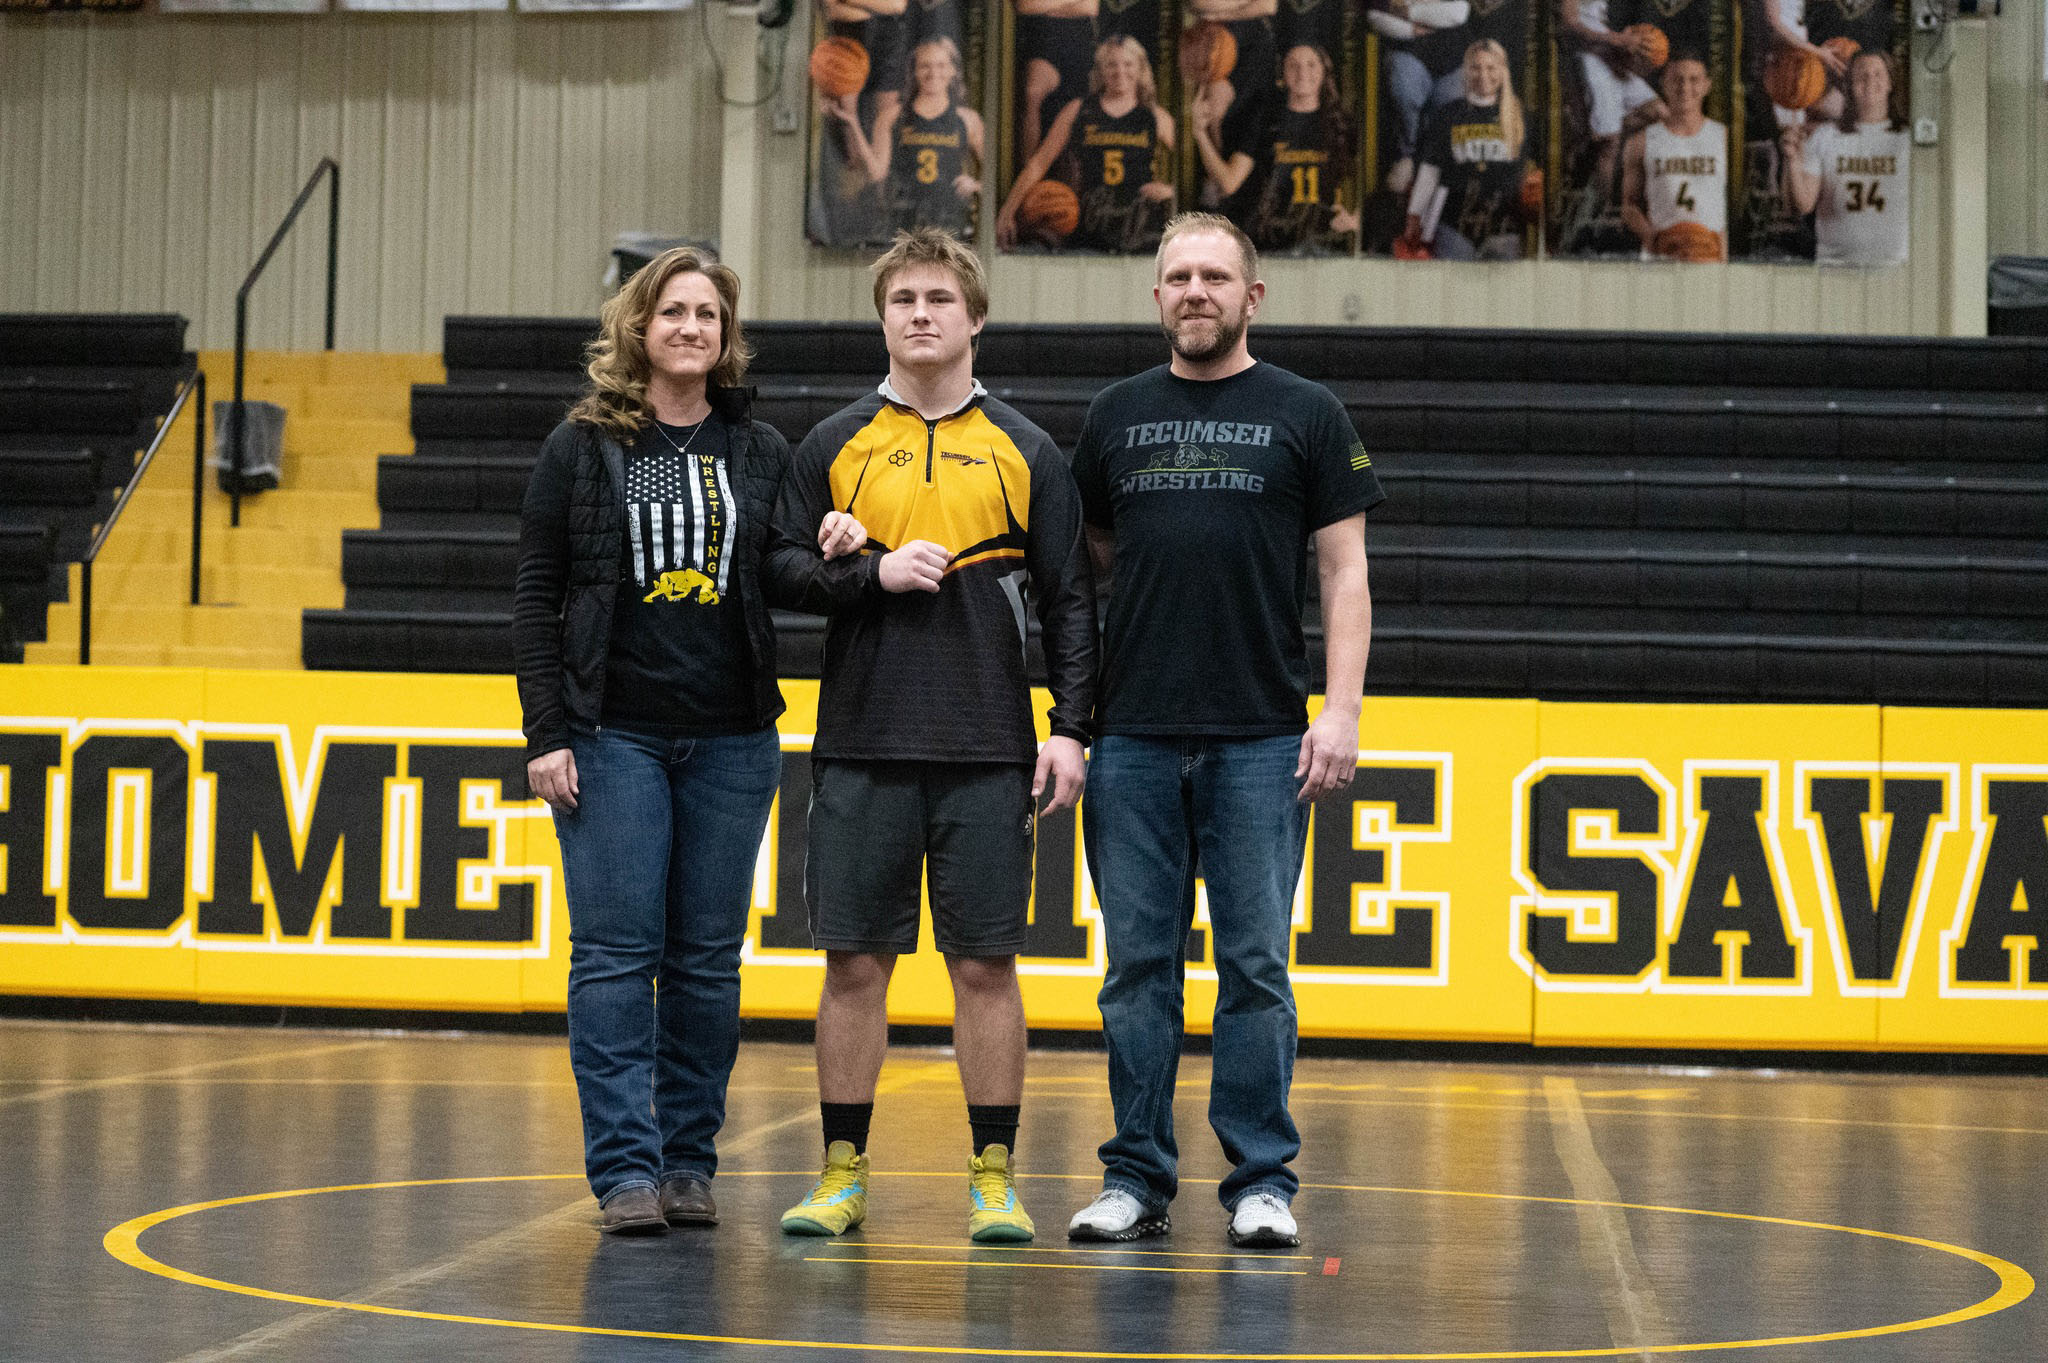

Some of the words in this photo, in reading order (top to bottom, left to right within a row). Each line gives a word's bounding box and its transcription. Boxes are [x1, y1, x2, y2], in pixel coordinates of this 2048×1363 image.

[916, 148, 939, 184] 3
[1103, 149, 1125, 186] 5
[1291, 165, 1319, 204] 11
[1676, 181, 1696, 212] 4
[1846, 181, 1886, 212] 34
[1125, 420, 1272, 449] TECUMSEH
[1119, 472, 1264, 494] WRESTLING
[699, 455, 721, 574] WRESTLING
